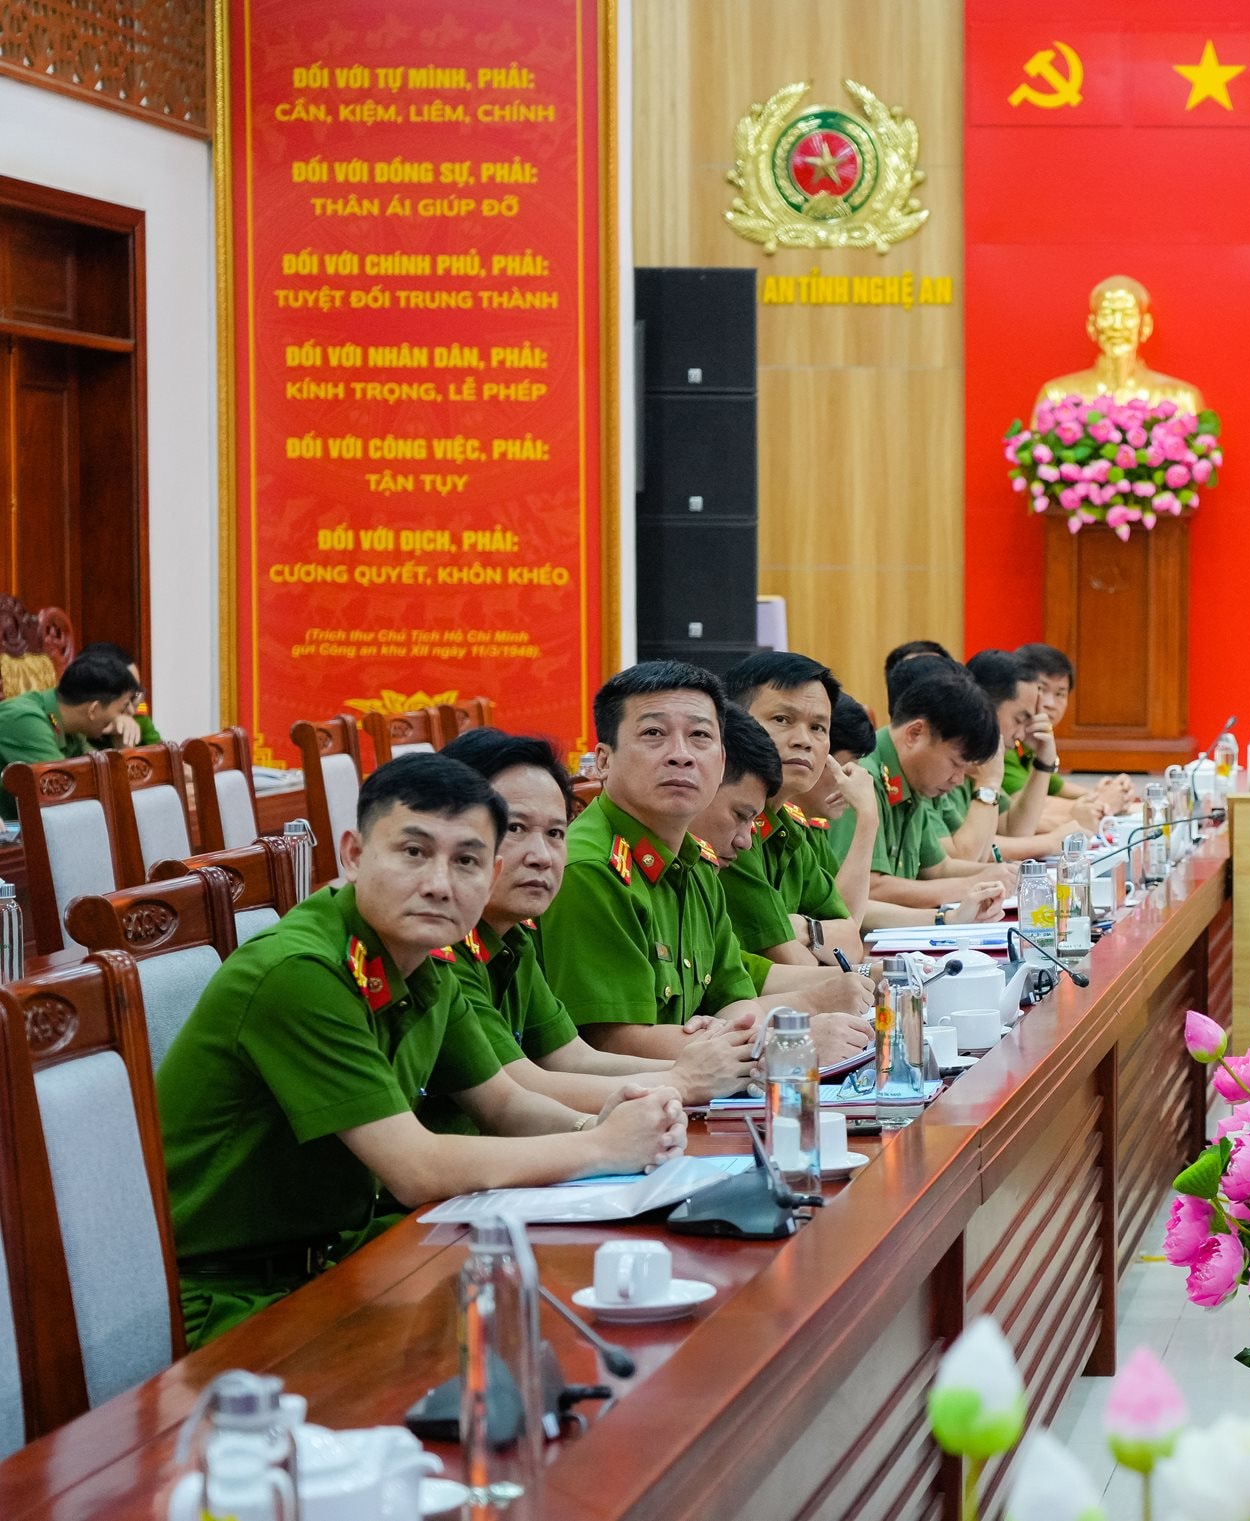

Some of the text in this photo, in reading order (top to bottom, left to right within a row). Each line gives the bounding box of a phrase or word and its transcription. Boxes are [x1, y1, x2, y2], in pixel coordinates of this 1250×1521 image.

[293, 62, 535, 93] ĐỐI VỚI TỰ MÌNH, PHẢI:
[274, 97, 556, 125] CẦN, KIỆM, LIÊM, CHÍNH
[291, 156, 538, 187] ĐỐI VỚI ĐỒNG SỰ, PHẢI:
[310, 194, 520, 217] THÂN ÁI GIÚP ĐỠ
[282, 249, 549, 278] ĐỐI VỚI CHÍNH PHỦ, PHẢI:
[274, 285, 559, 312] TUYỆT ĐỐI TRUNG THÀNH
[763, 265, 953, 311] AN TỈNH NGHỆ AN
[285, 340, 548, 370] ĐỐI VỚI NHÂN DÂN, PHẢI:
[285, 376, 548, 405] KÍNH TRỌNG, LỄ PHÉP
[285, 432, 550, 464] ĐỐI VỚI CÔNG VIỆC, PHẢI:
[365, 469, 469, 496] TẬN TỤY
[317, 523, 519, 555] ĐỐI VỚI ĐỊCH, PHẢI:
[268, 560, 570, 587] CƯƠNG QUYẾT, KHÔN KHÉO
